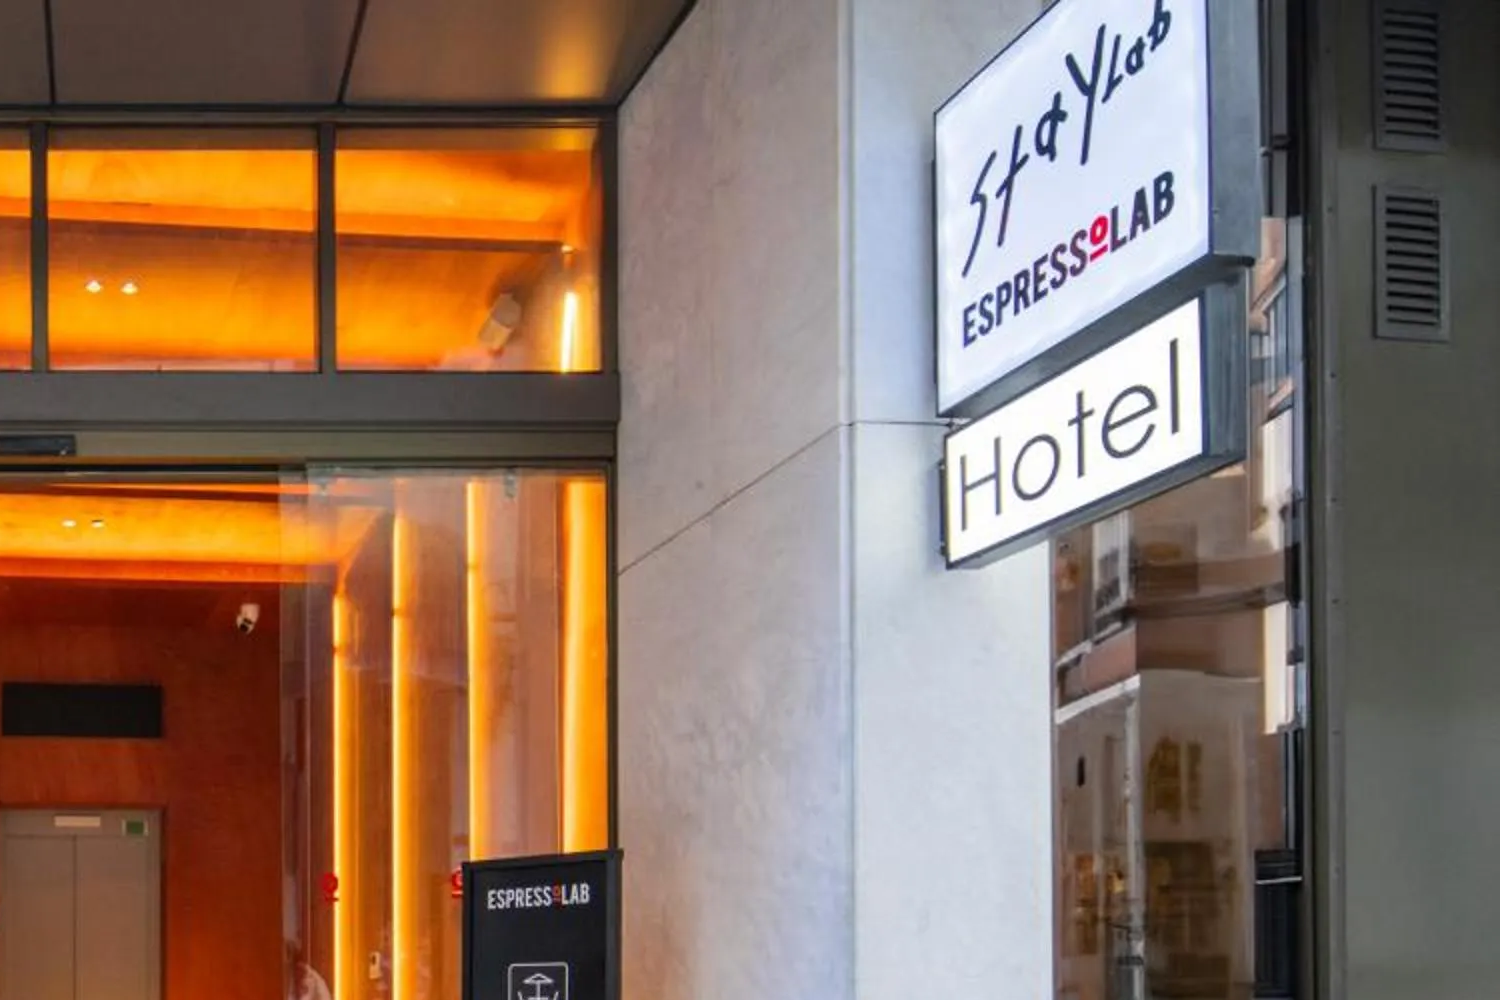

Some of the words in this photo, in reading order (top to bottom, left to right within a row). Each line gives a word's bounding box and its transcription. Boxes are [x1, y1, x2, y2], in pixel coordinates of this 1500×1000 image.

[962, 171, 1175, 348] ESPRESSOLAB
[960, 338, 1180, 532] Hotel
[487, 881, 591, 910] ESPRESSOLAB
